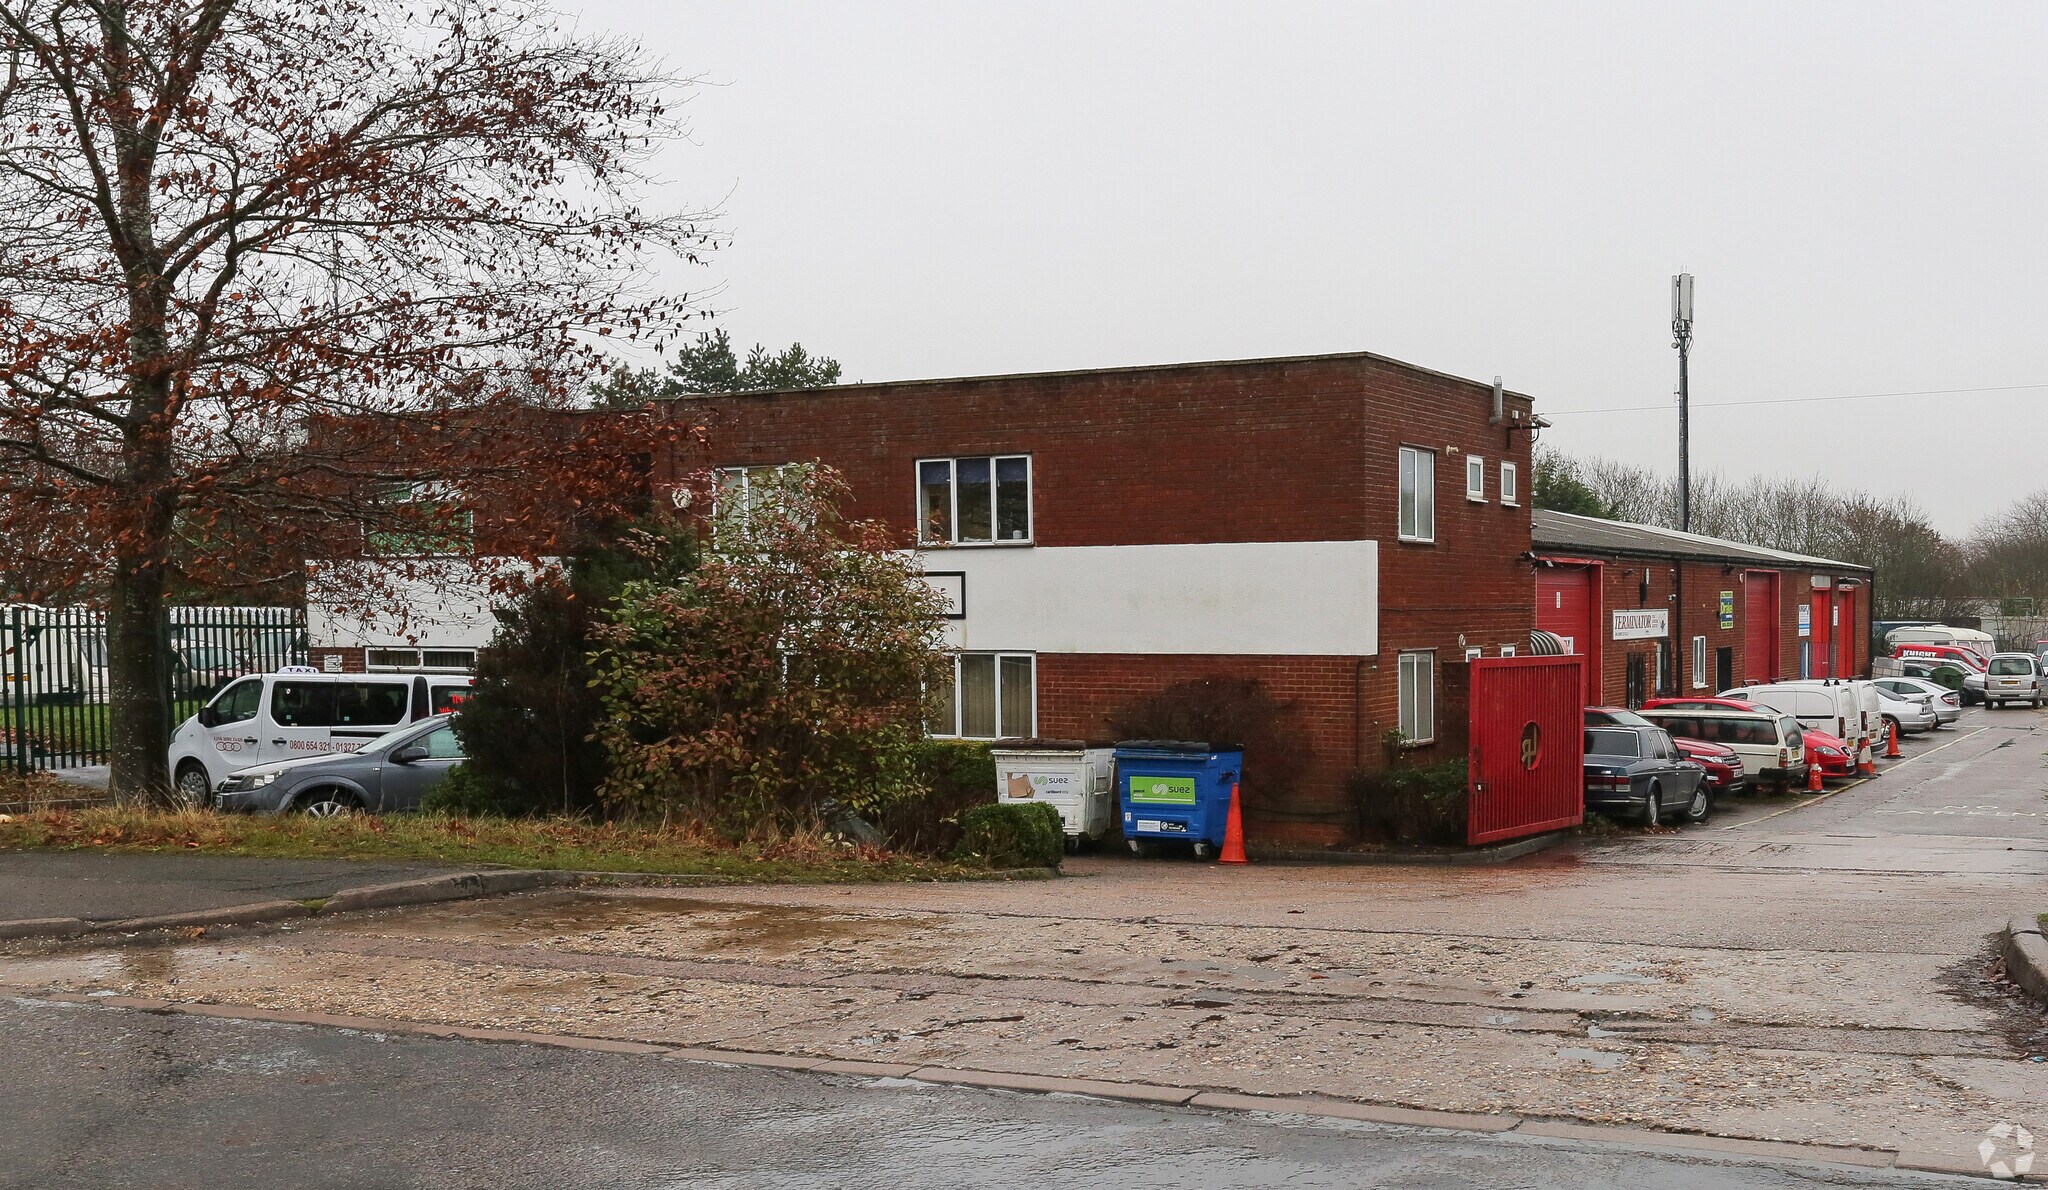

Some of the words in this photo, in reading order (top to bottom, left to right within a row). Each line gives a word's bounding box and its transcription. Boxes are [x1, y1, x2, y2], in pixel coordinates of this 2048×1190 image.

[1614, 614, 1652, 630] TERMINATOR
[1902, 650, 1938, 658] KNIGHT
[289, 740, 305, 750] 0800
[305, 741, 318, 751] 654
[318, 742, 330, 751] 321
[335, 742, 356, 753] 01327
[1168, 786, 1190, 794] suez
